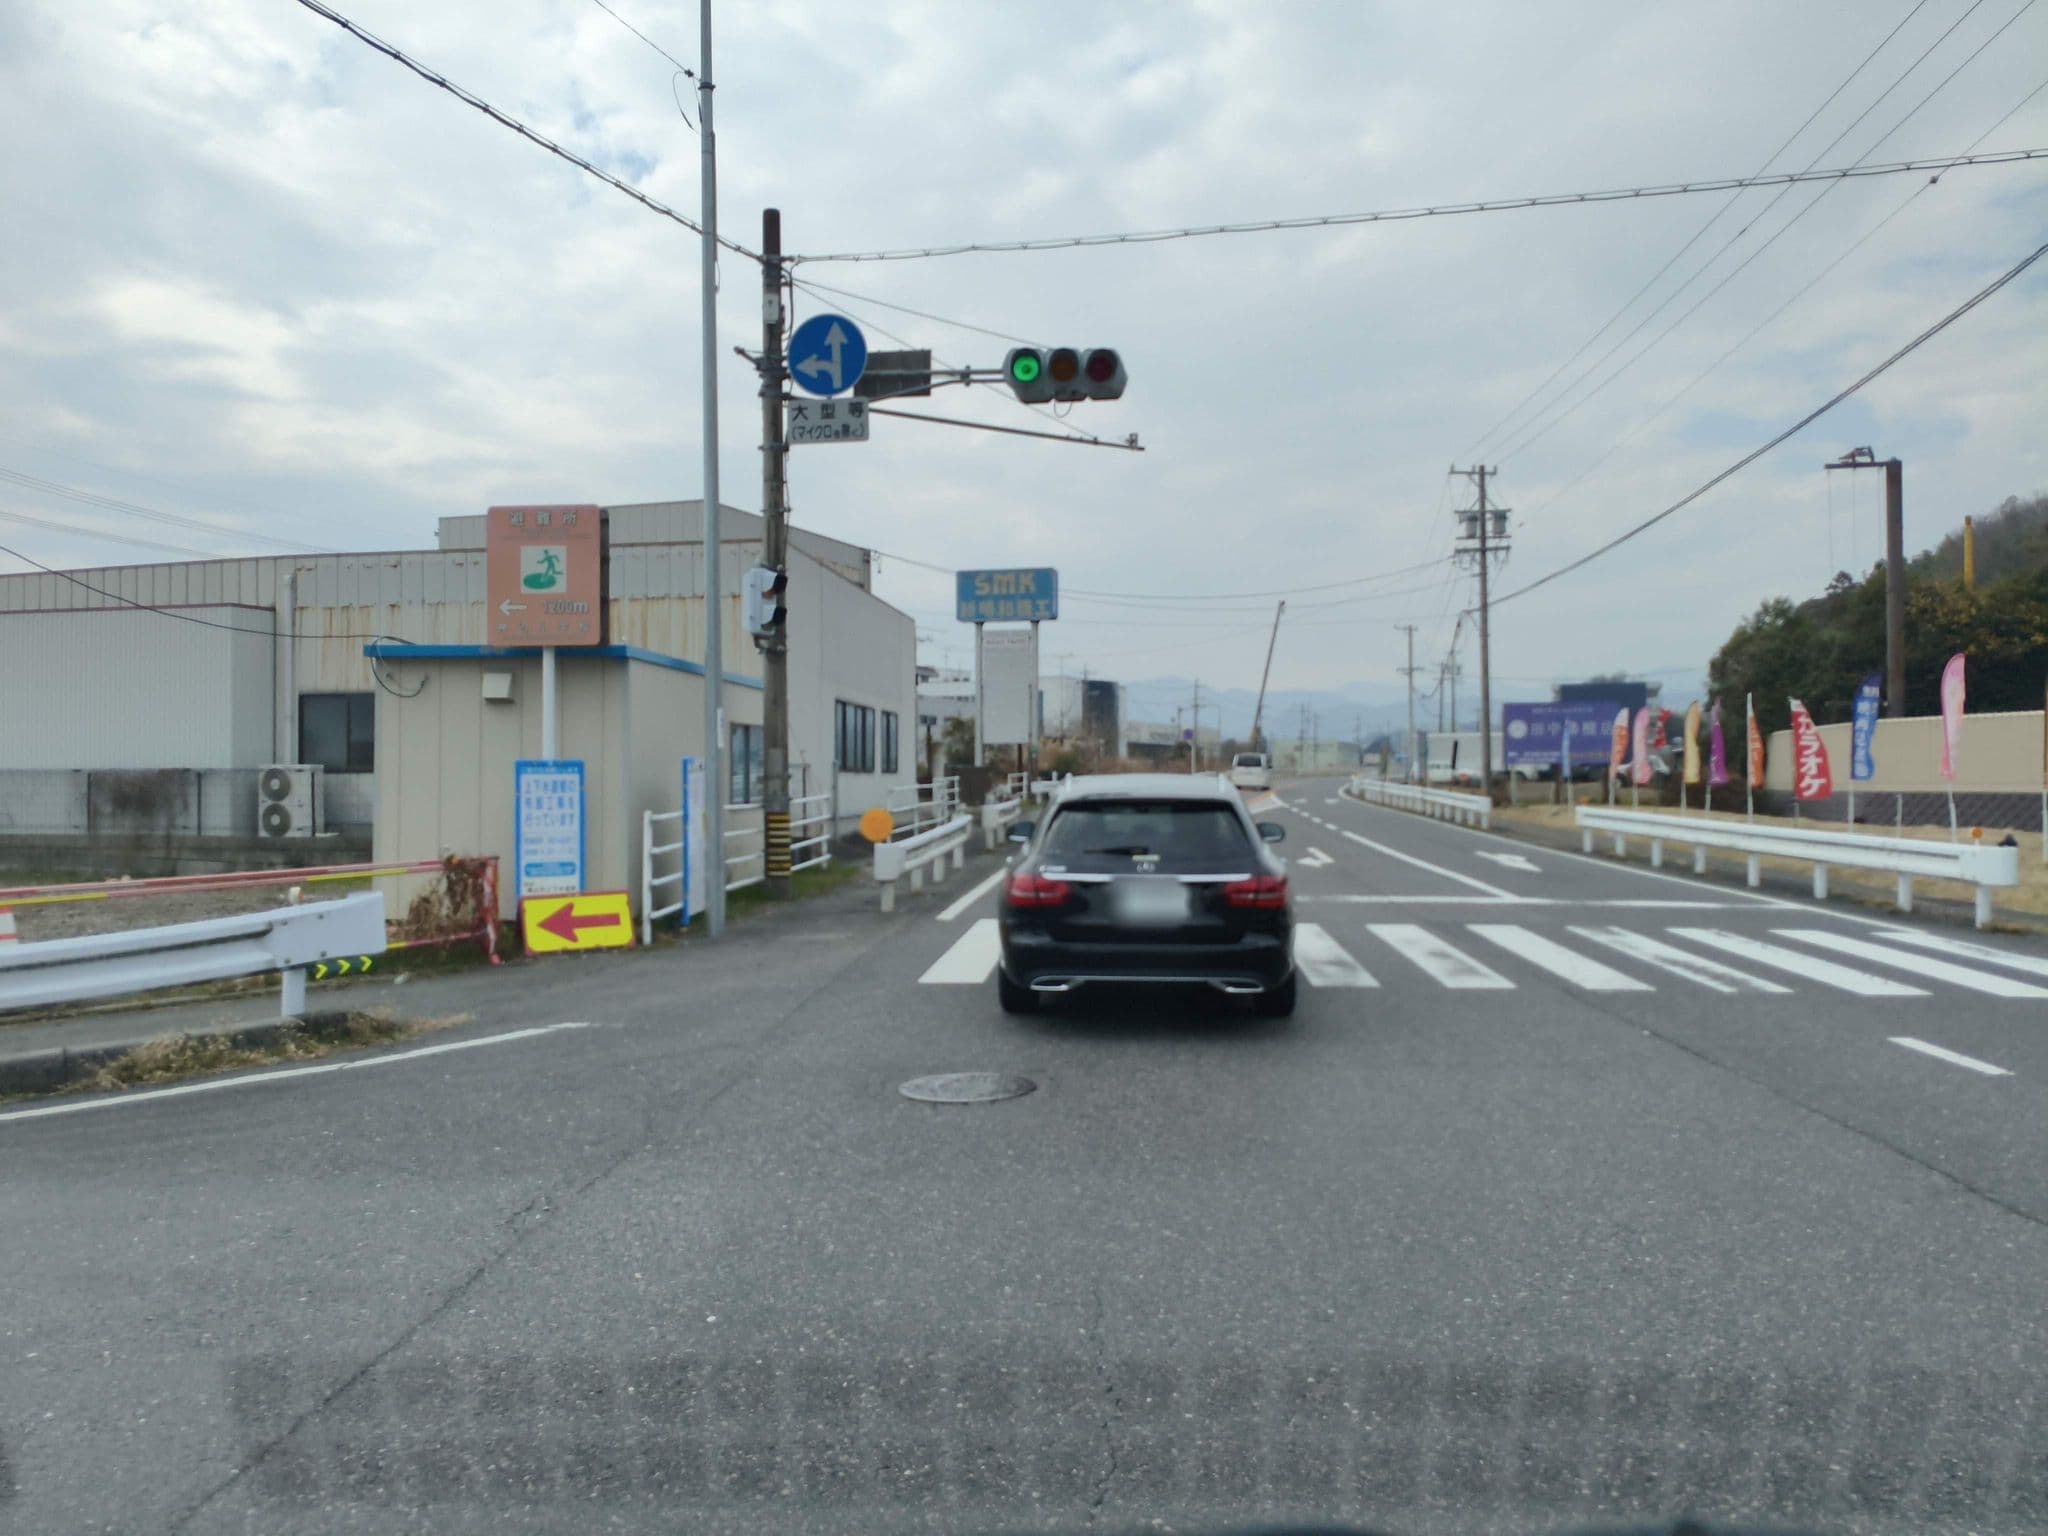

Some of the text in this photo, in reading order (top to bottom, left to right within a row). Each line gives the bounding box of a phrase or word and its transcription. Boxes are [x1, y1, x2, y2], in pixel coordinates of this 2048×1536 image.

[975, 574, 1037, 596] SMK
[1798, 714, 1828, 797] カラオケ
